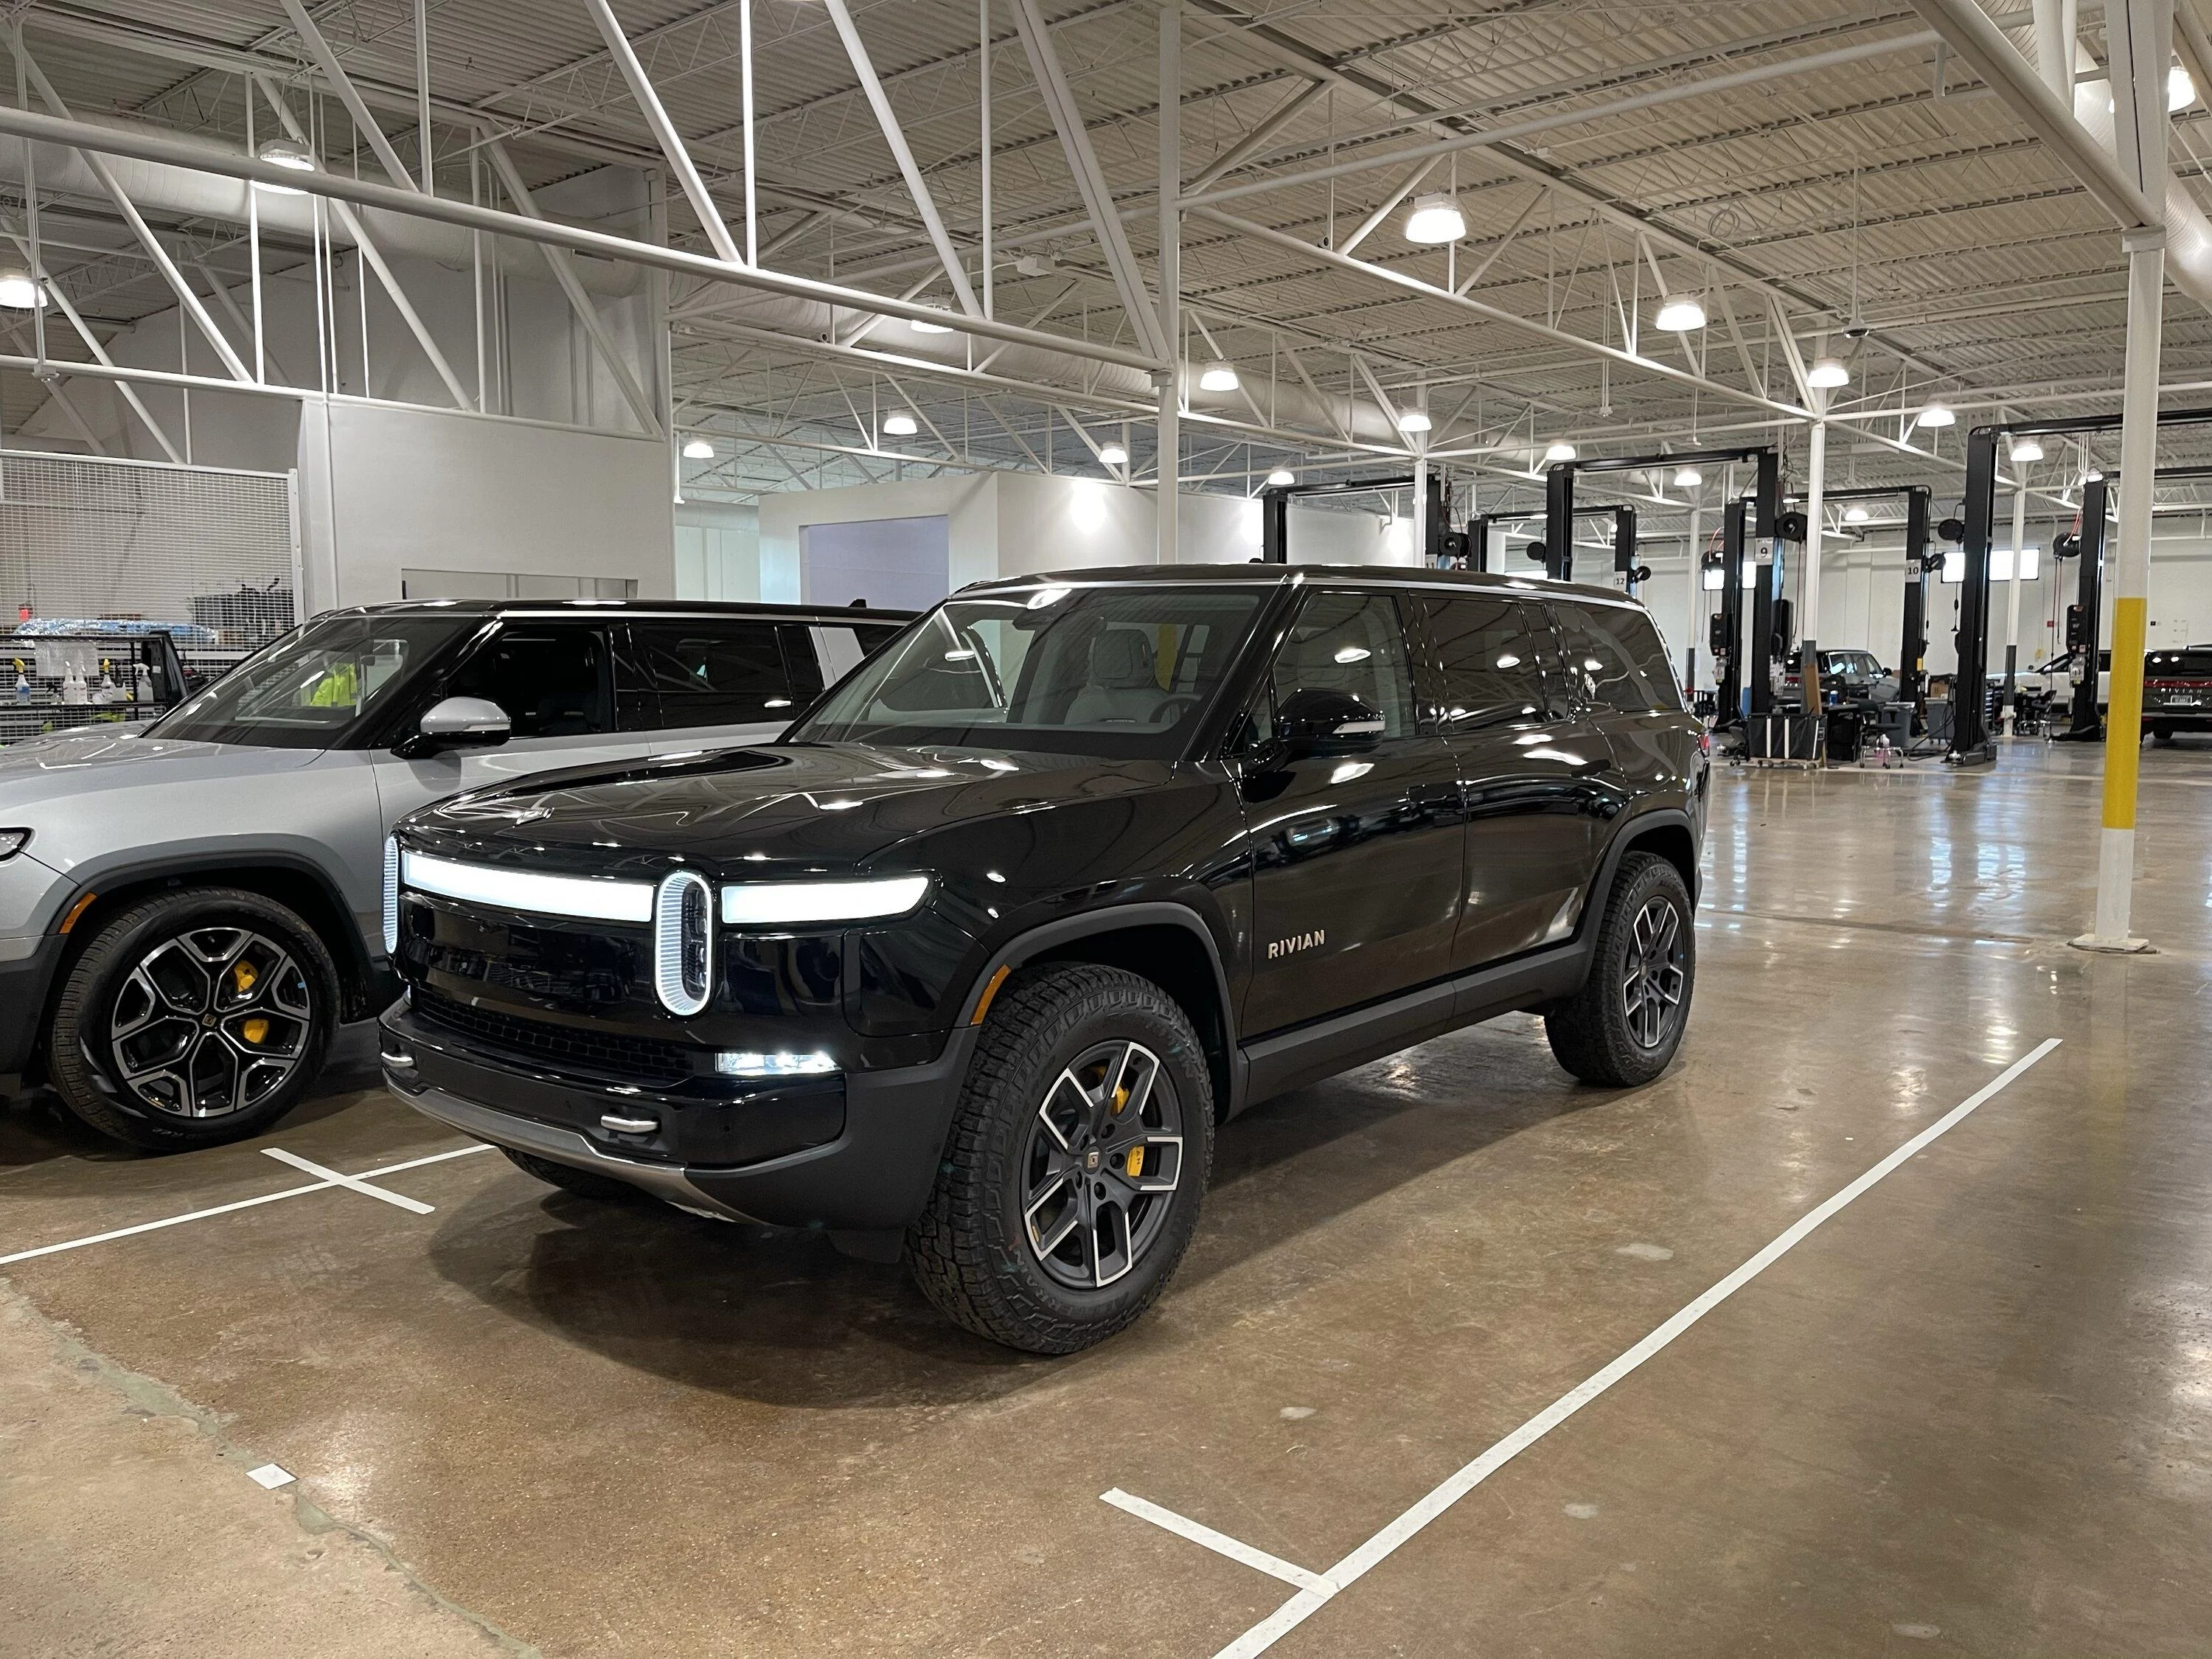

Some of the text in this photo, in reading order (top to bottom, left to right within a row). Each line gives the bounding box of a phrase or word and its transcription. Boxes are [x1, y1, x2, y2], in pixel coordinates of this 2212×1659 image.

[1760, 547, 1768, 558] 9
[1907, 567, 1919, 575] 10
[1267, 929, 1325, 959] RIVIAN
